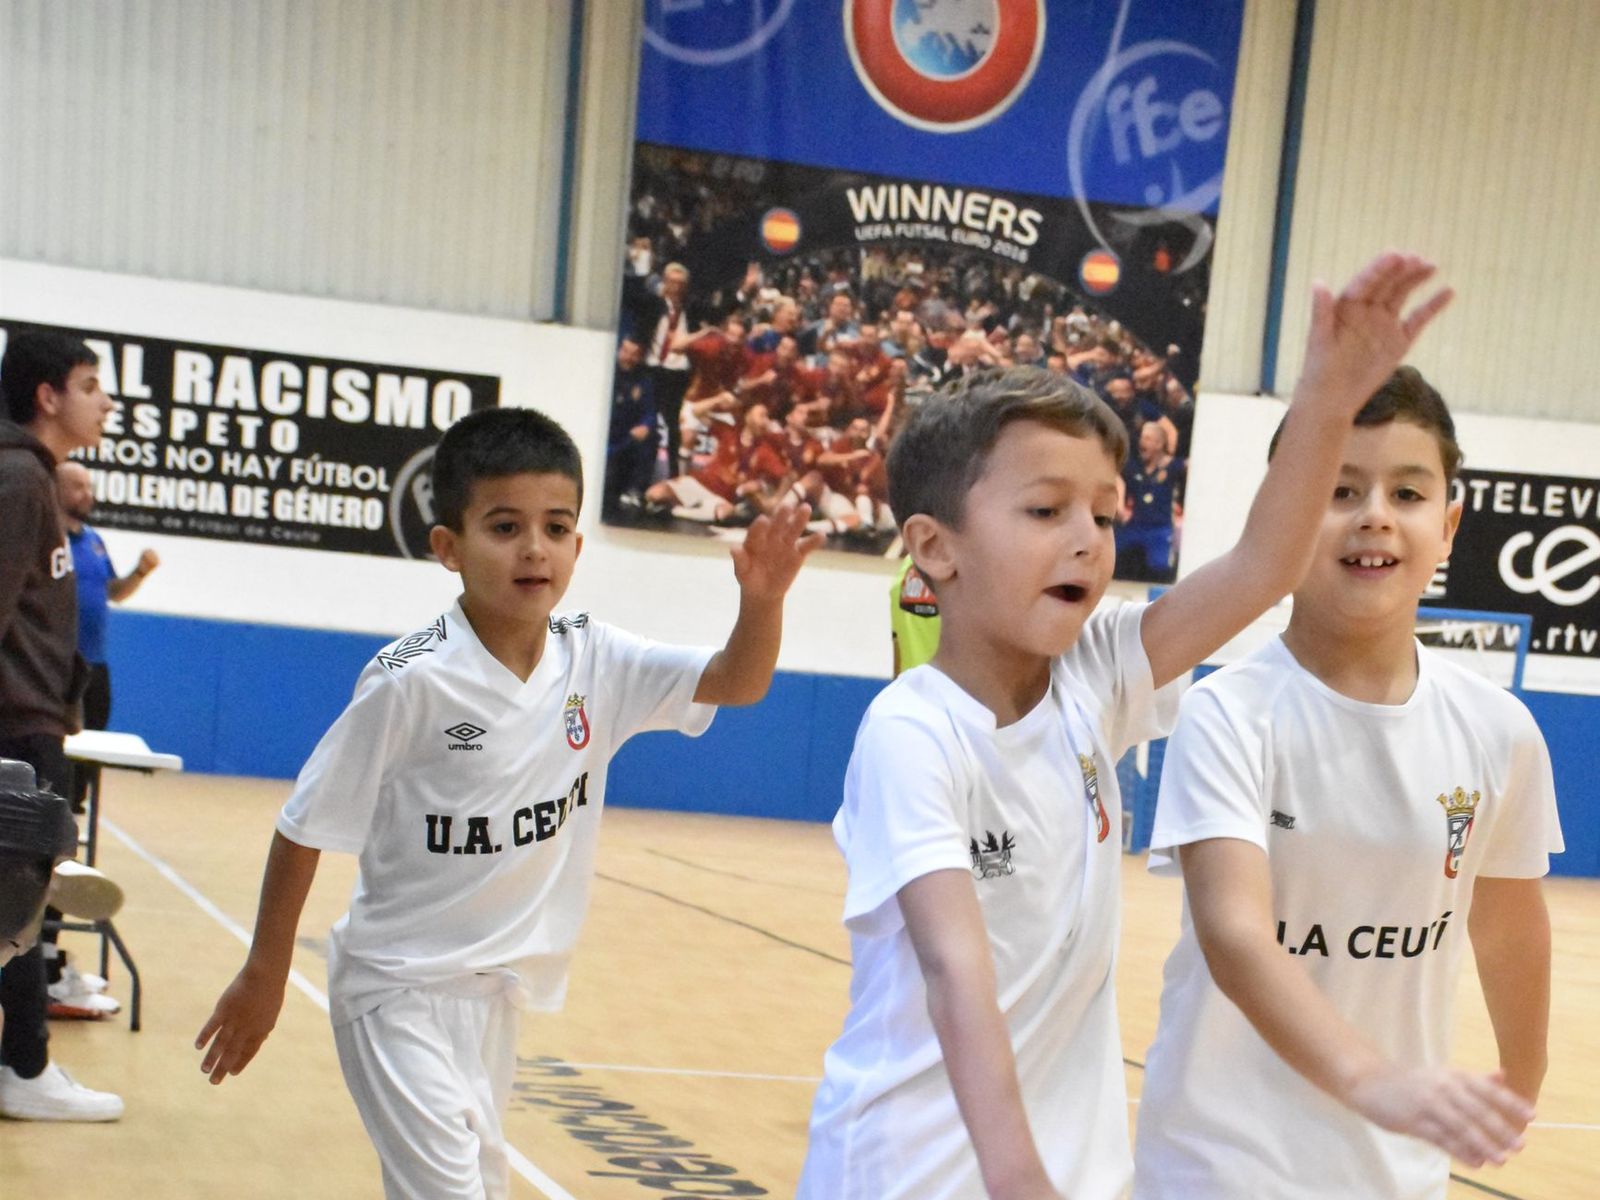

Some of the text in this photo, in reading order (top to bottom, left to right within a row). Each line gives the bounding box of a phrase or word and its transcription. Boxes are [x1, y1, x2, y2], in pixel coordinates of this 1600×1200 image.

[846, 184, 1044, 246] WINNERS
[172, 349, 472, 432] RACISMO
[102, 399, 299, 453] ESPETO
[165, 444, 214, 474] NO
[221, 450, 283, 480] HAY
[290, 453, 390, 492] FÚTBOL
[231, 484, 269, 519] DE
[273, 485, 384, 531] GÉNERO
[448, 742, 483, 752] umbro
[425, 814, 502, 855] U.A.
